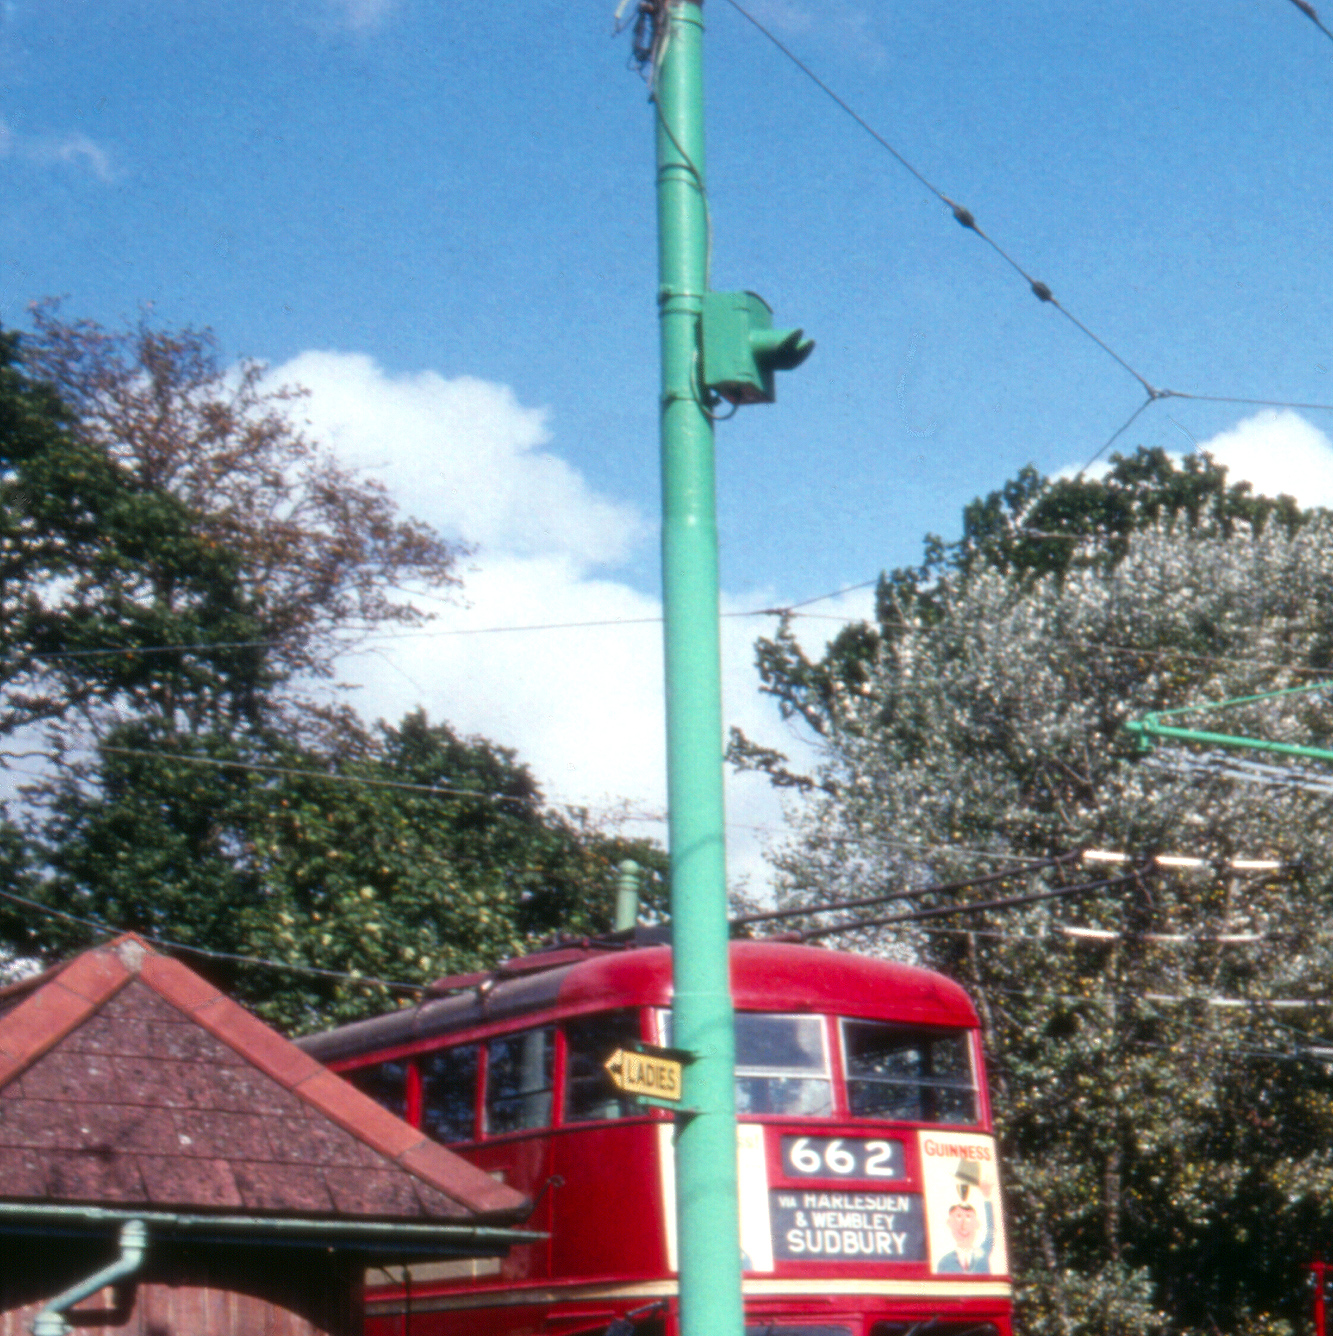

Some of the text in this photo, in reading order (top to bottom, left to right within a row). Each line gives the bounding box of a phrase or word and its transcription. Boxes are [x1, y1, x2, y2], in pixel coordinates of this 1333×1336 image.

[627, 1058, 675, 1091] LADIES
[790, 1137, 893, 1176] 662
[924, 1138, 991, 1161] GUINNESS
[778, 1193, 909, 1212] VIA HARLESDEN
[795, 1210, 895, 1231] & WEMBLEY
[786, 1228, 907, 1255] SUDBURY
